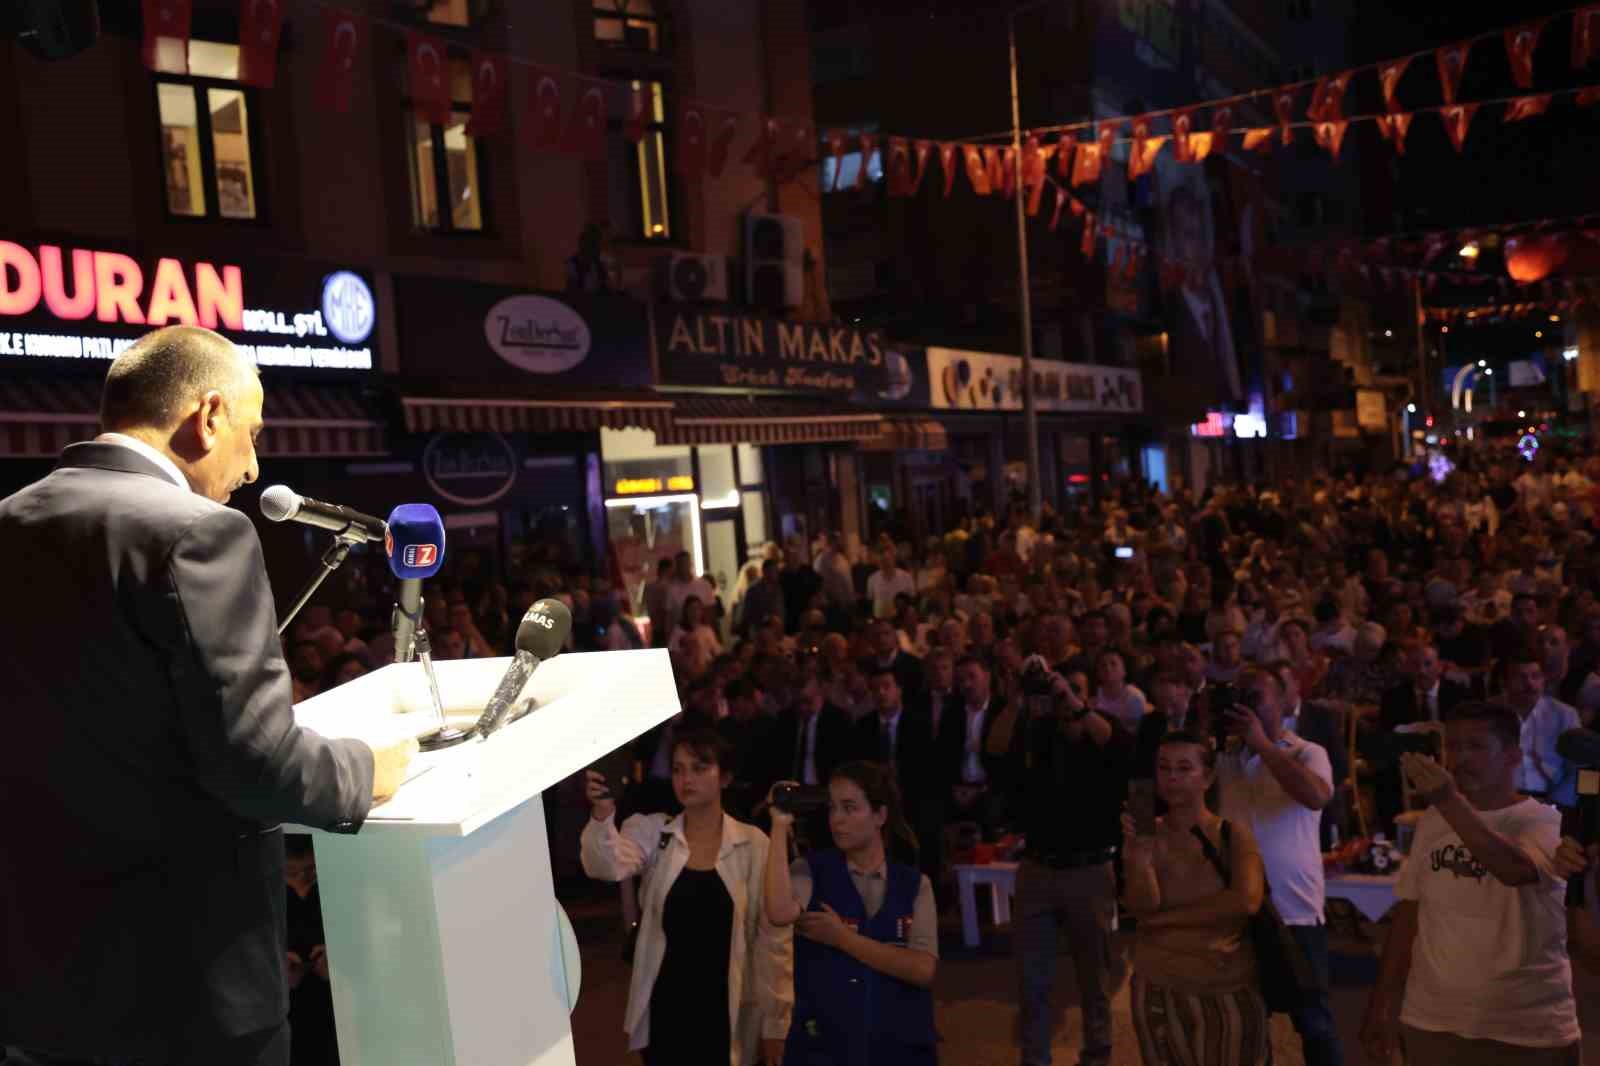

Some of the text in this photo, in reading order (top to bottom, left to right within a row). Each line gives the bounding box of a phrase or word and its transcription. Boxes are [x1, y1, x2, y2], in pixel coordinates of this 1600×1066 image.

[0, 239, 245, 331] DURAN
[667, 313, 882, 366] ALTIN MAKAS
[419, 546, 433, 564] Z
